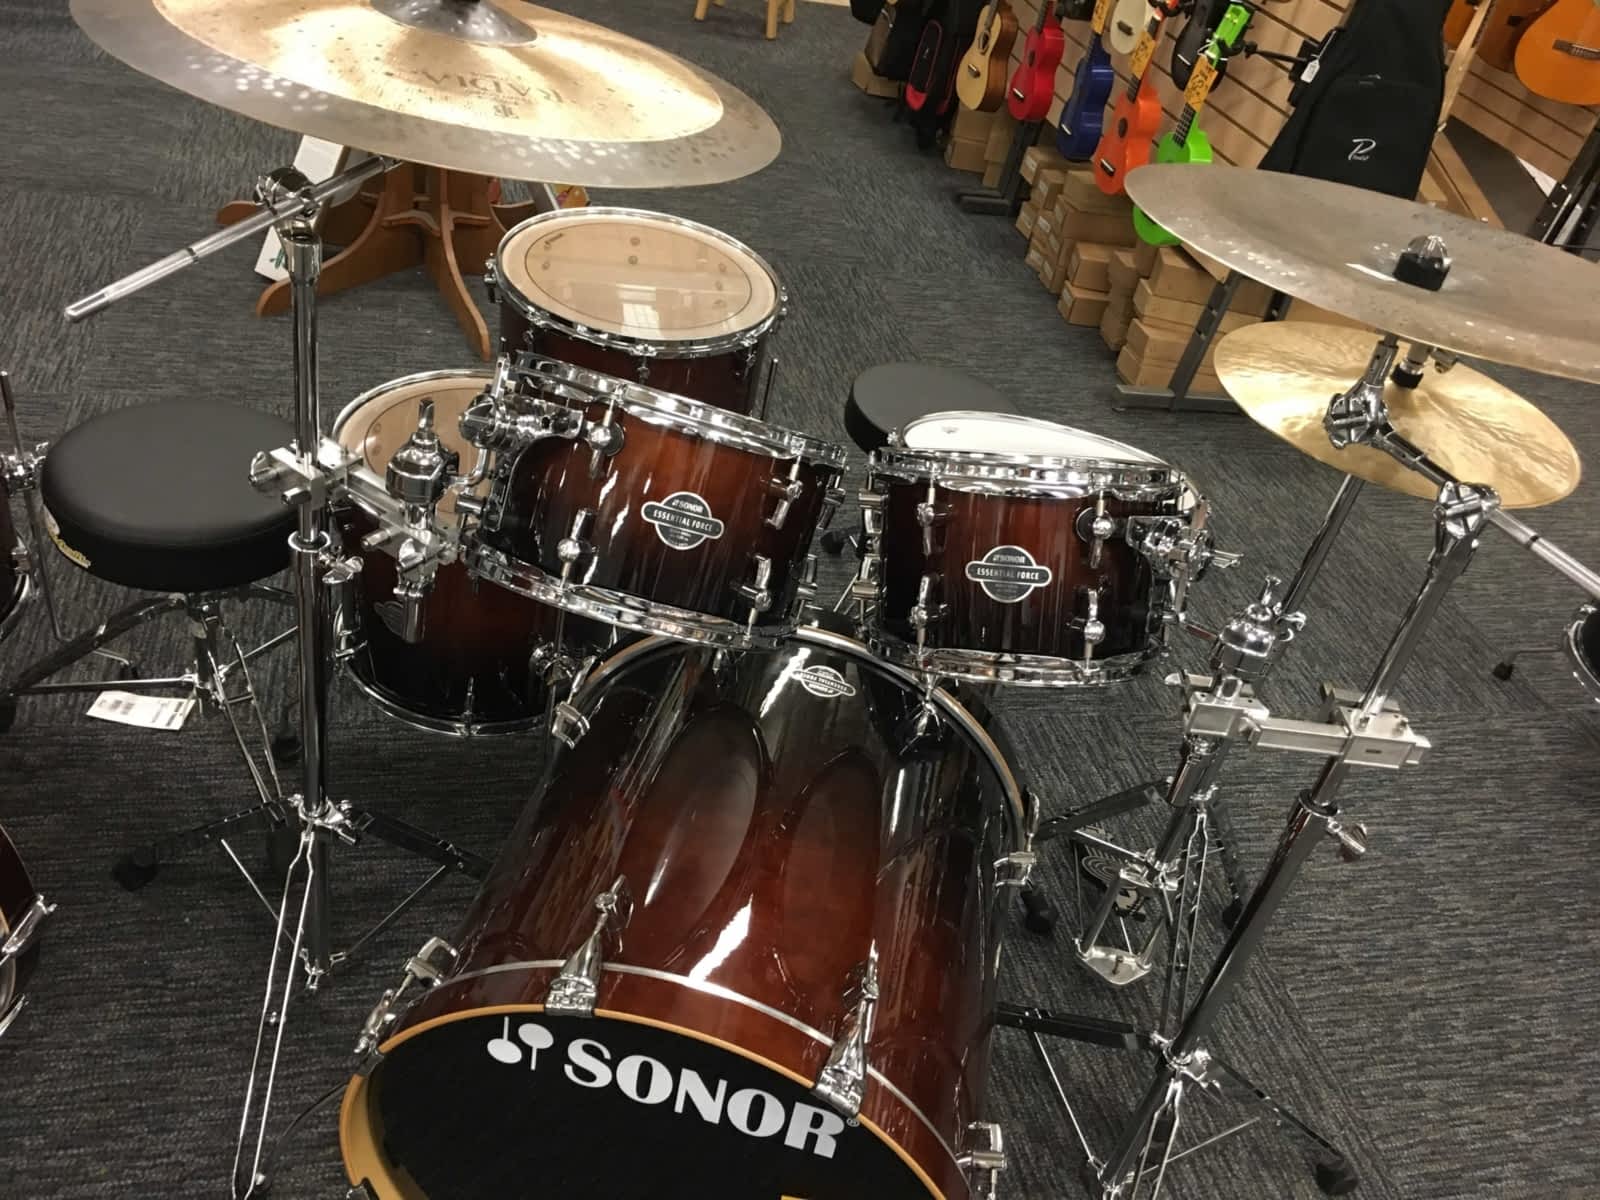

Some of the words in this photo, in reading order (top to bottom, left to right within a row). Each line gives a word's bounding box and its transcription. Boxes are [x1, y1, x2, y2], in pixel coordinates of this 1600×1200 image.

[653, 509, 690, 526] ESSENTIAL
[691, 520, 713, 532] FORCE
[977, 568, 1015, 578] ESSENTIAL
[1017, 571, 1040, 580] FORCE
[563, 1038, 845, 1159] SONOR
